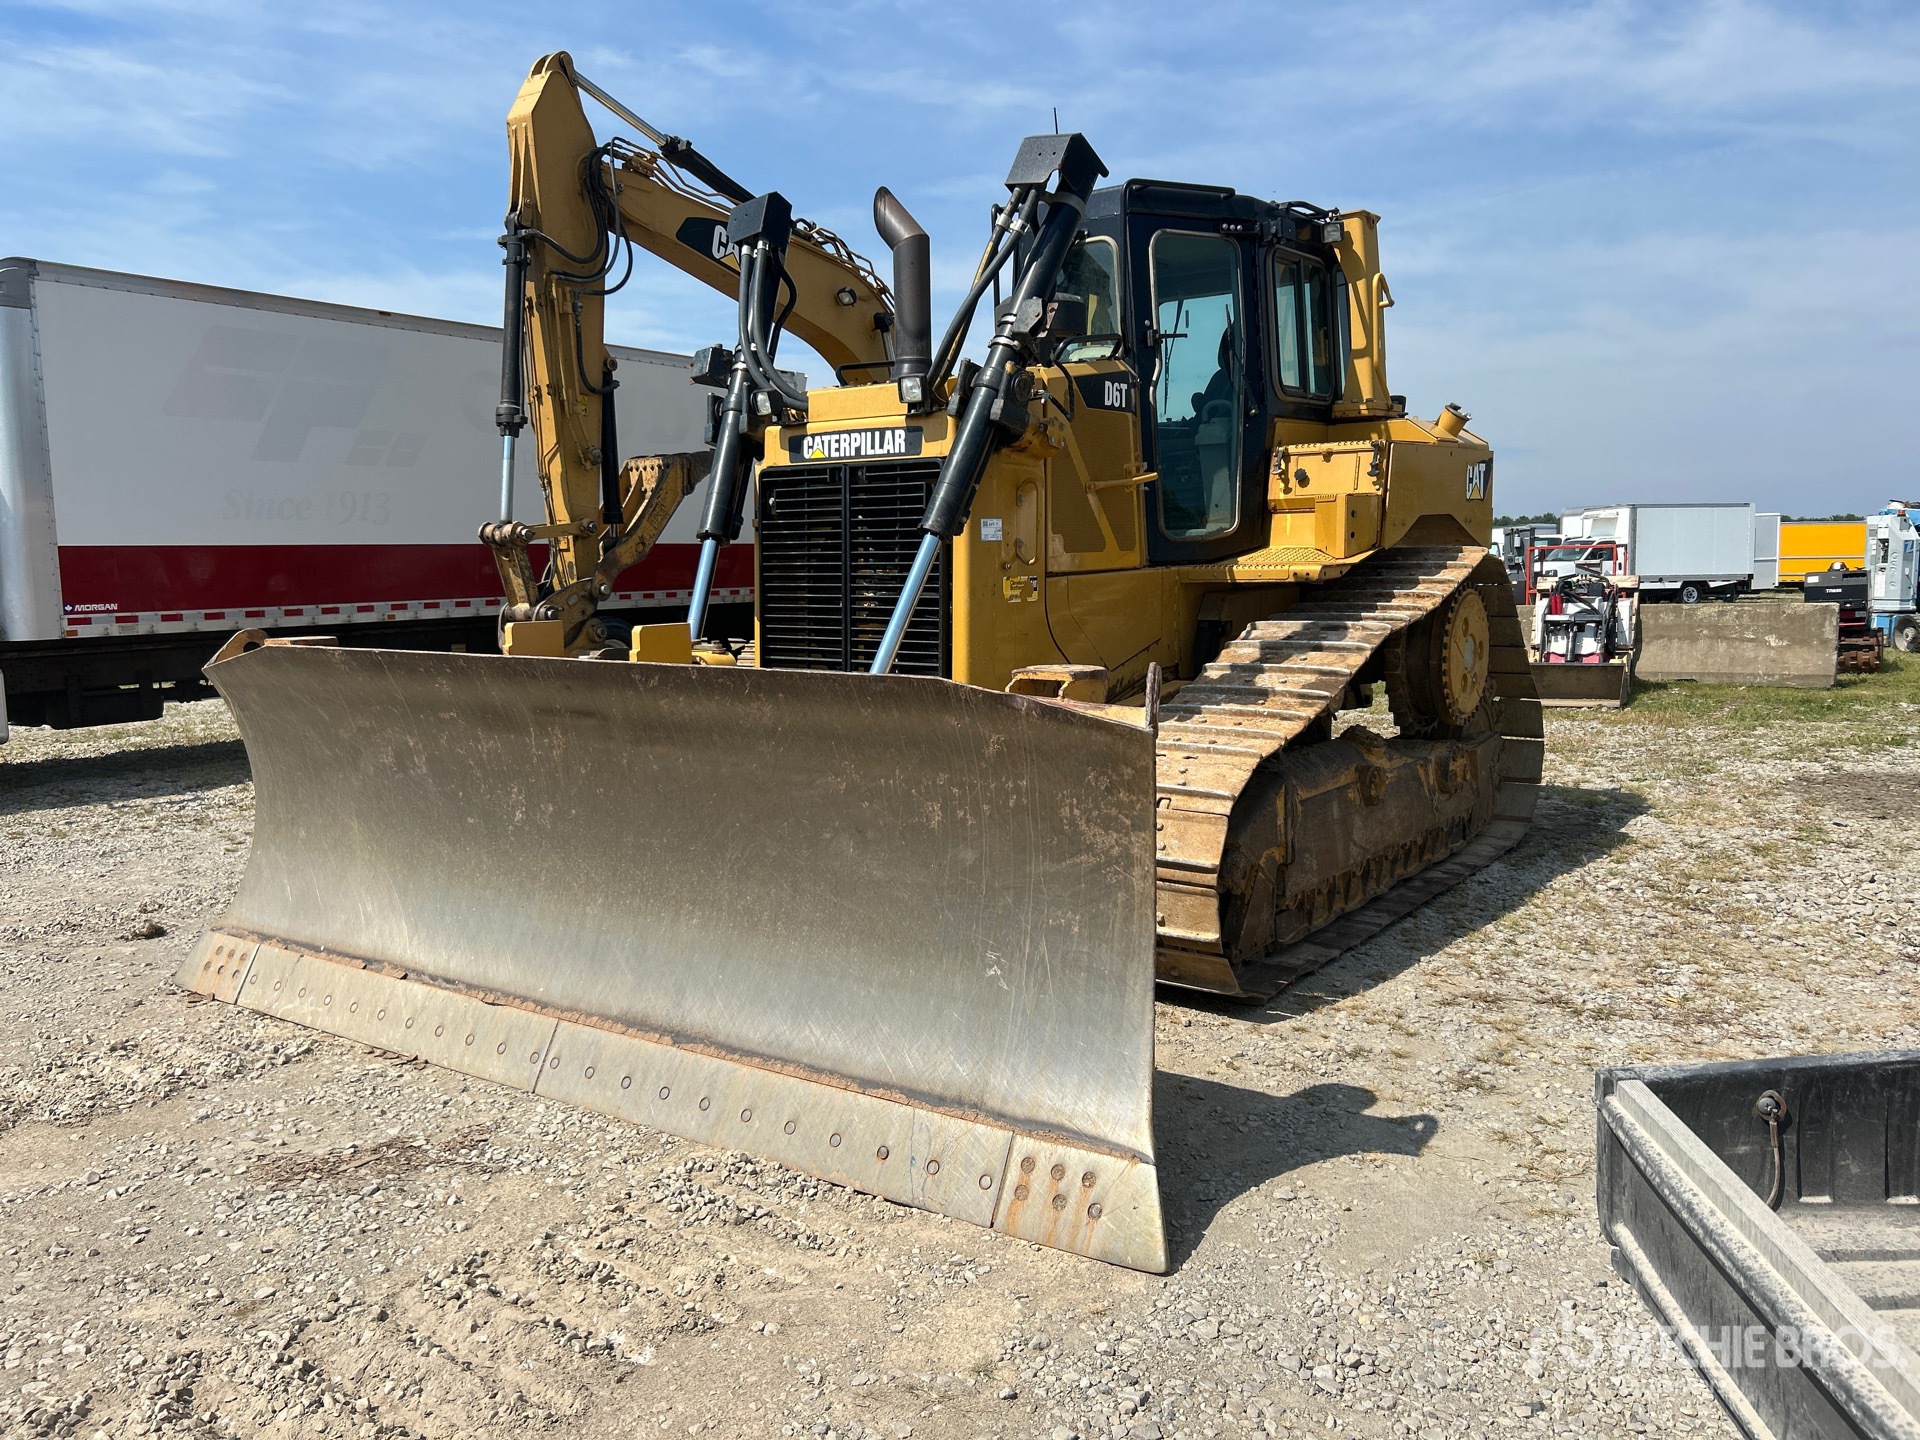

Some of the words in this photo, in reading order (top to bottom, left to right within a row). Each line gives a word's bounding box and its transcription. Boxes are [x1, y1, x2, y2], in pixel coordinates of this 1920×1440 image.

[1104, 380, 1128, 408] D6T
[803, 428, 906, 459] CATERPILLAR
[1466, 463, 1486, 500] CAT
[222, 488, 313, 521] Since
[74, 603, 118, 612] MORGAN
